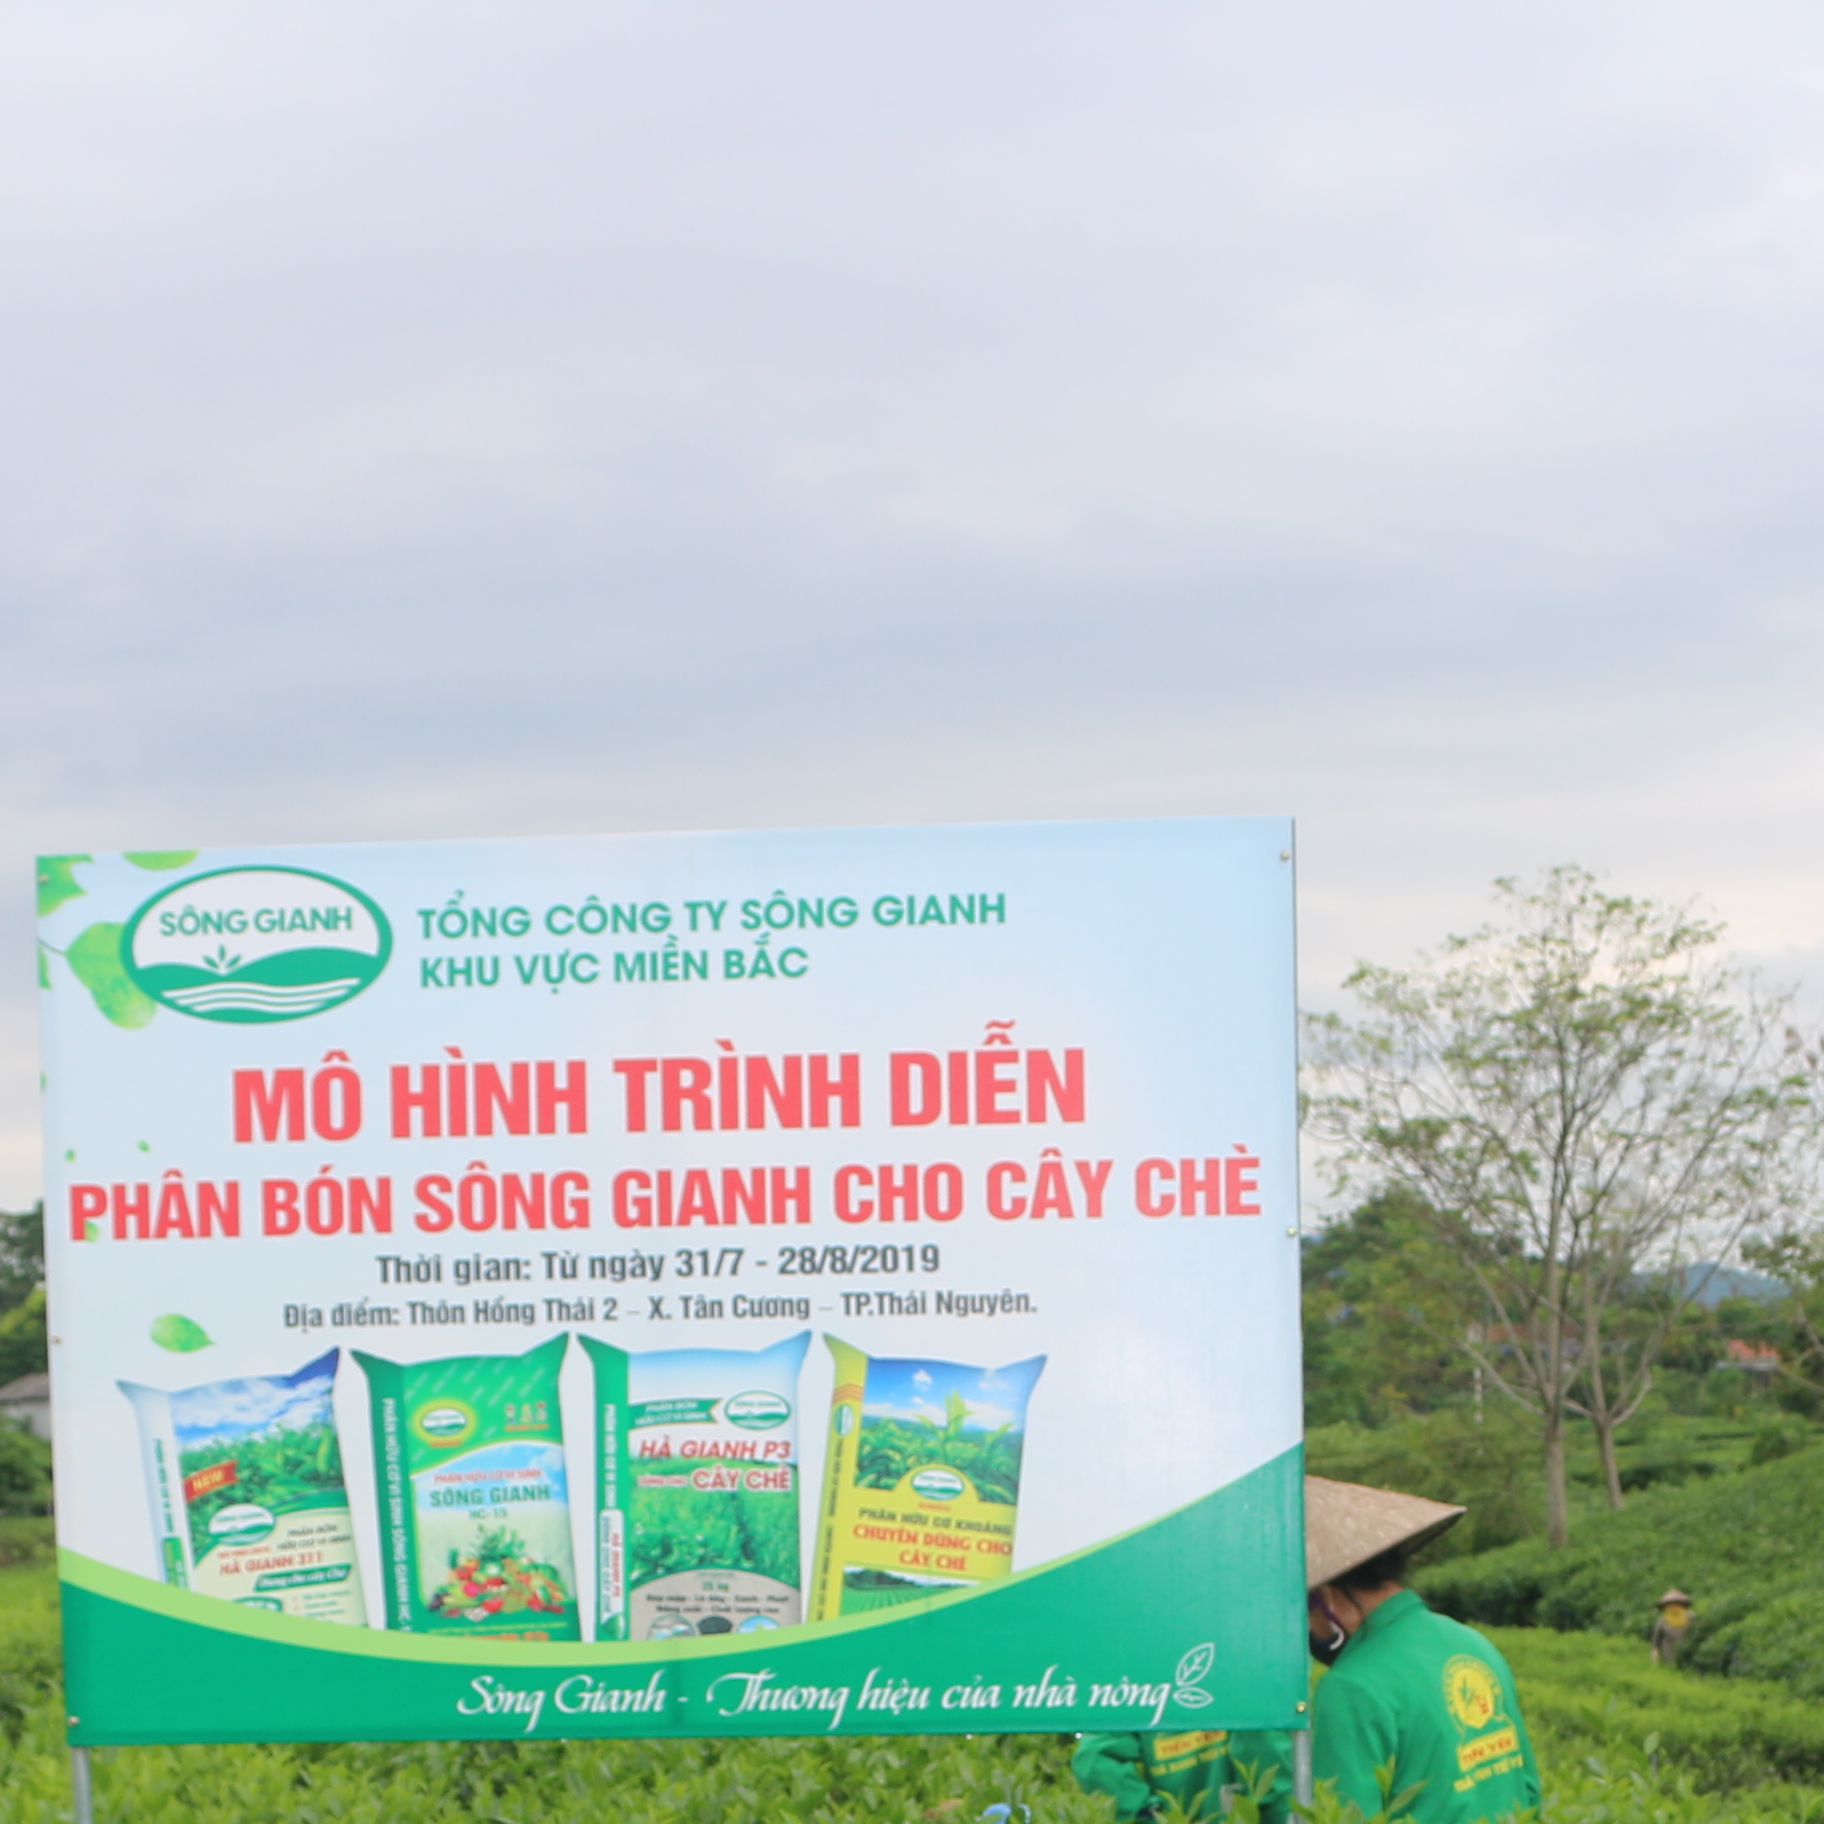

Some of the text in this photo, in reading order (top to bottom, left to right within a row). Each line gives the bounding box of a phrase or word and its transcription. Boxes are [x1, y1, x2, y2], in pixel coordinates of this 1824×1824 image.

[160, 905, 352, 936] SÔNG GIANH
[418, 889, 1005, 939] TỔNG CÔNG TY SÔNG GIANH
[420, 932, 809, 993] KHU VỰC MIỀN BẮC
[232, 1019, 1086, 1143] MÔ HÌNH TRÌNH DIỄN
[69, 1143, 1261, 1241] PHÂN BÓN SÔNG GIANH CHO CÂY CHÈ
[375, 1251, 443, 1284] Thời
[453, 1253, 531, 1286] gian:
[542, 1249, 578, 1280] Từ
[589, 1248, 664, 1283] ngày
[675, 1247, 745, 1278] 31/7
[777, 1244, 940, 1275] 28/8/2019
[283, 1303, 322, 1333] Địa
[407, 1300, 465, 1325] Thôn
[543, 1299, 595, 1322] Thái
[602, 1300, 618, 1321] 2
[648, 1295, 671, 1320] X.
[680, 1293, 723, 1318] Tân
[732, 1294, 810, 1320] Cương
[841, 1291, 927, 1316] TP.Thái
[936, 1288, 1037, 1318] Nguyên.
[680, 1440, 757, 1459] GIANH
[764, 1440, 792, 1459] P3
[192, 1469, 224, 1490] NEW
[429, 1485, 551, 1507] SÔNG GIANH
[693, 1463, 740, 1489] CÂY
[859, 1507, 897, 1522] PHÂN
[456, 1674, 546, 1733] Sông
[553, 1668, 667, 1714] Gianh
[705, 1667, 850, 1731] Thương
[857, 1666, 930, 1715] hiệu
[941, 1674, 1003, 1710] của
[1012, 1664, 1077, 1709] nhà
[1087, 1675, 1172, 1728] nông
